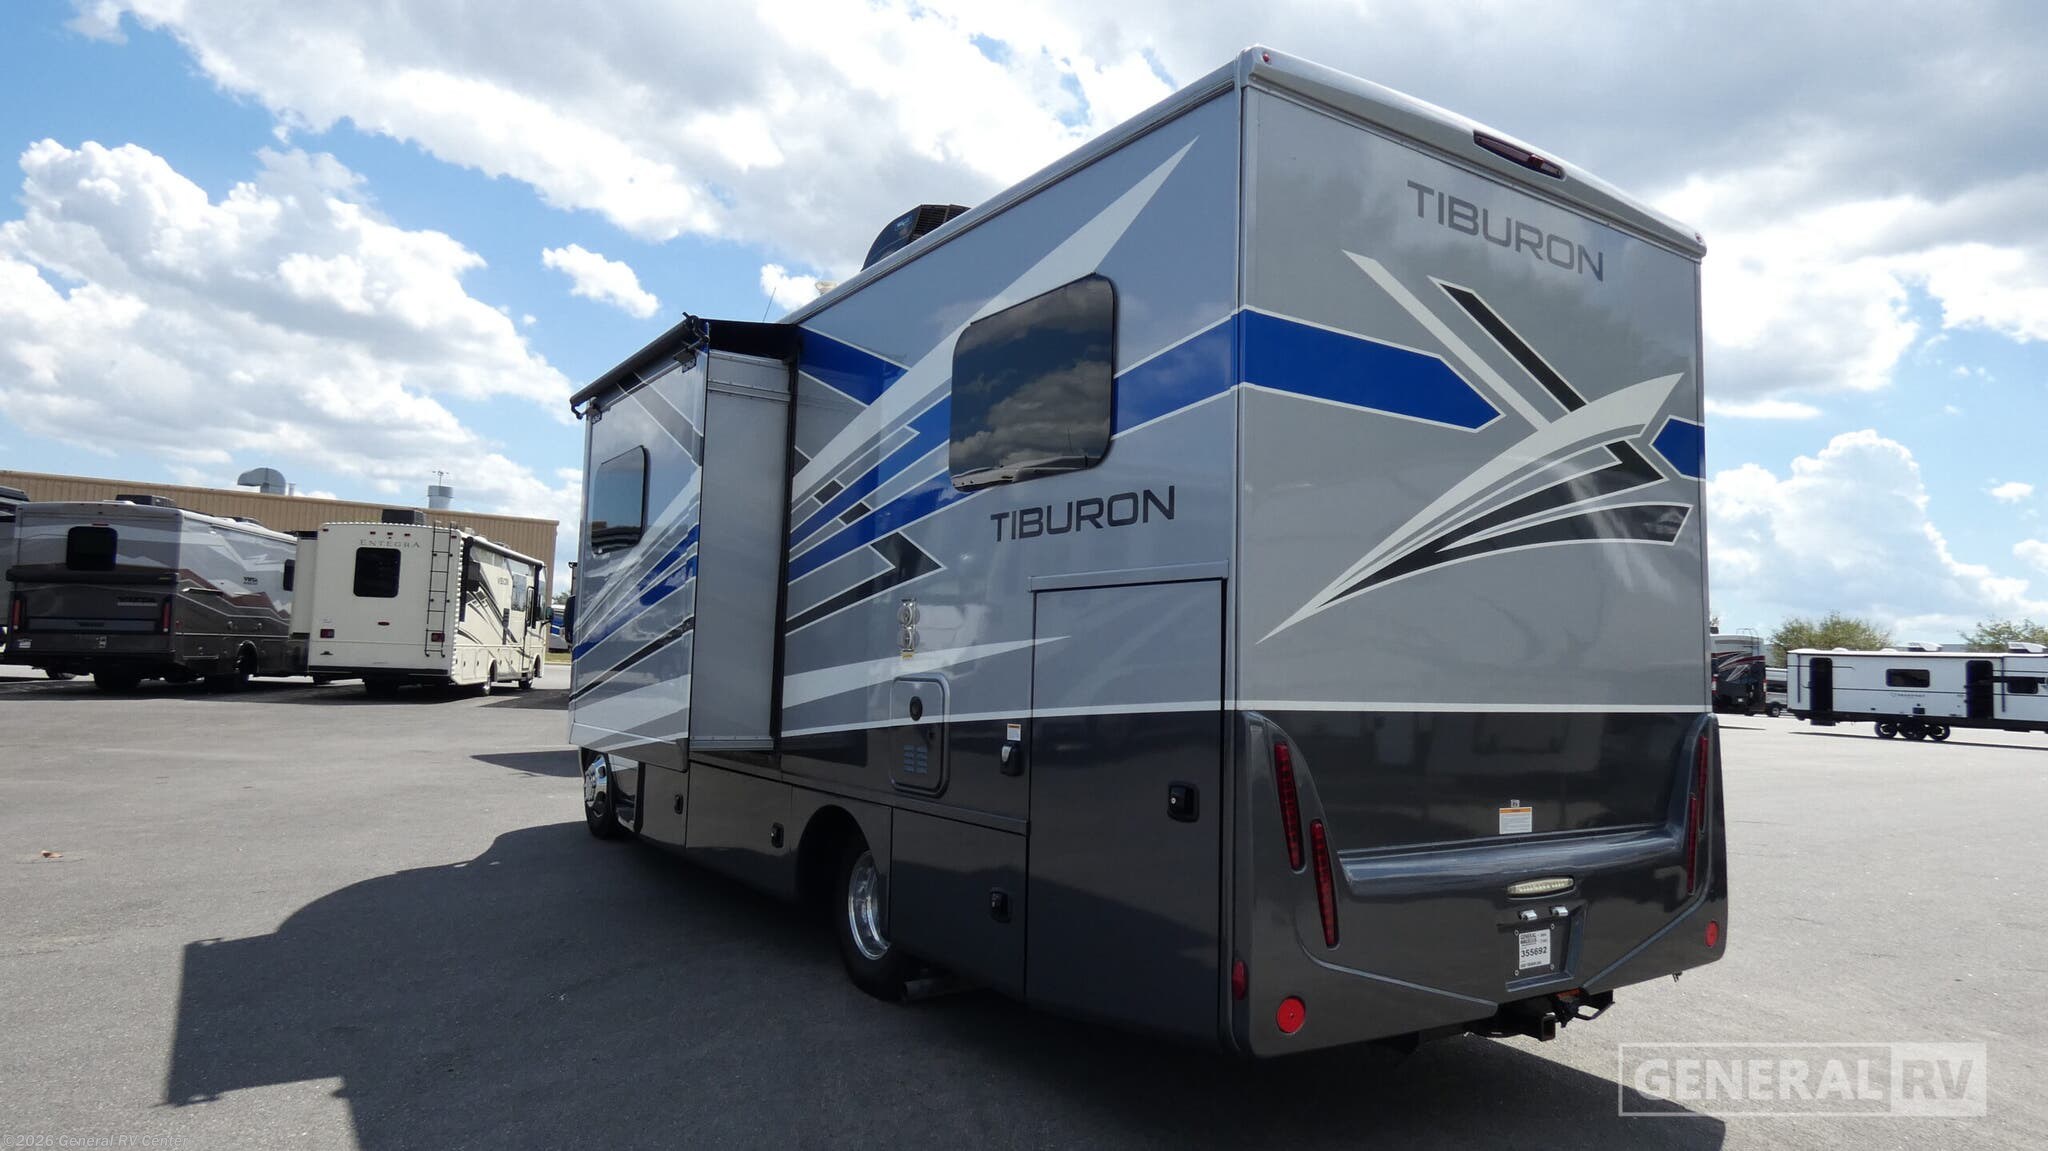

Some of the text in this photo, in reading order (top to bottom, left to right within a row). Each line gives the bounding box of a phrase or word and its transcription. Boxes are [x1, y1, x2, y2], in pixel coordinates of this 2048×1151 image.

[1407, 179, 1604, 282] TIBURON
[990, 485, 1176, 543] TIBURON
[360, 539, 421, 549] ENTEGRA
